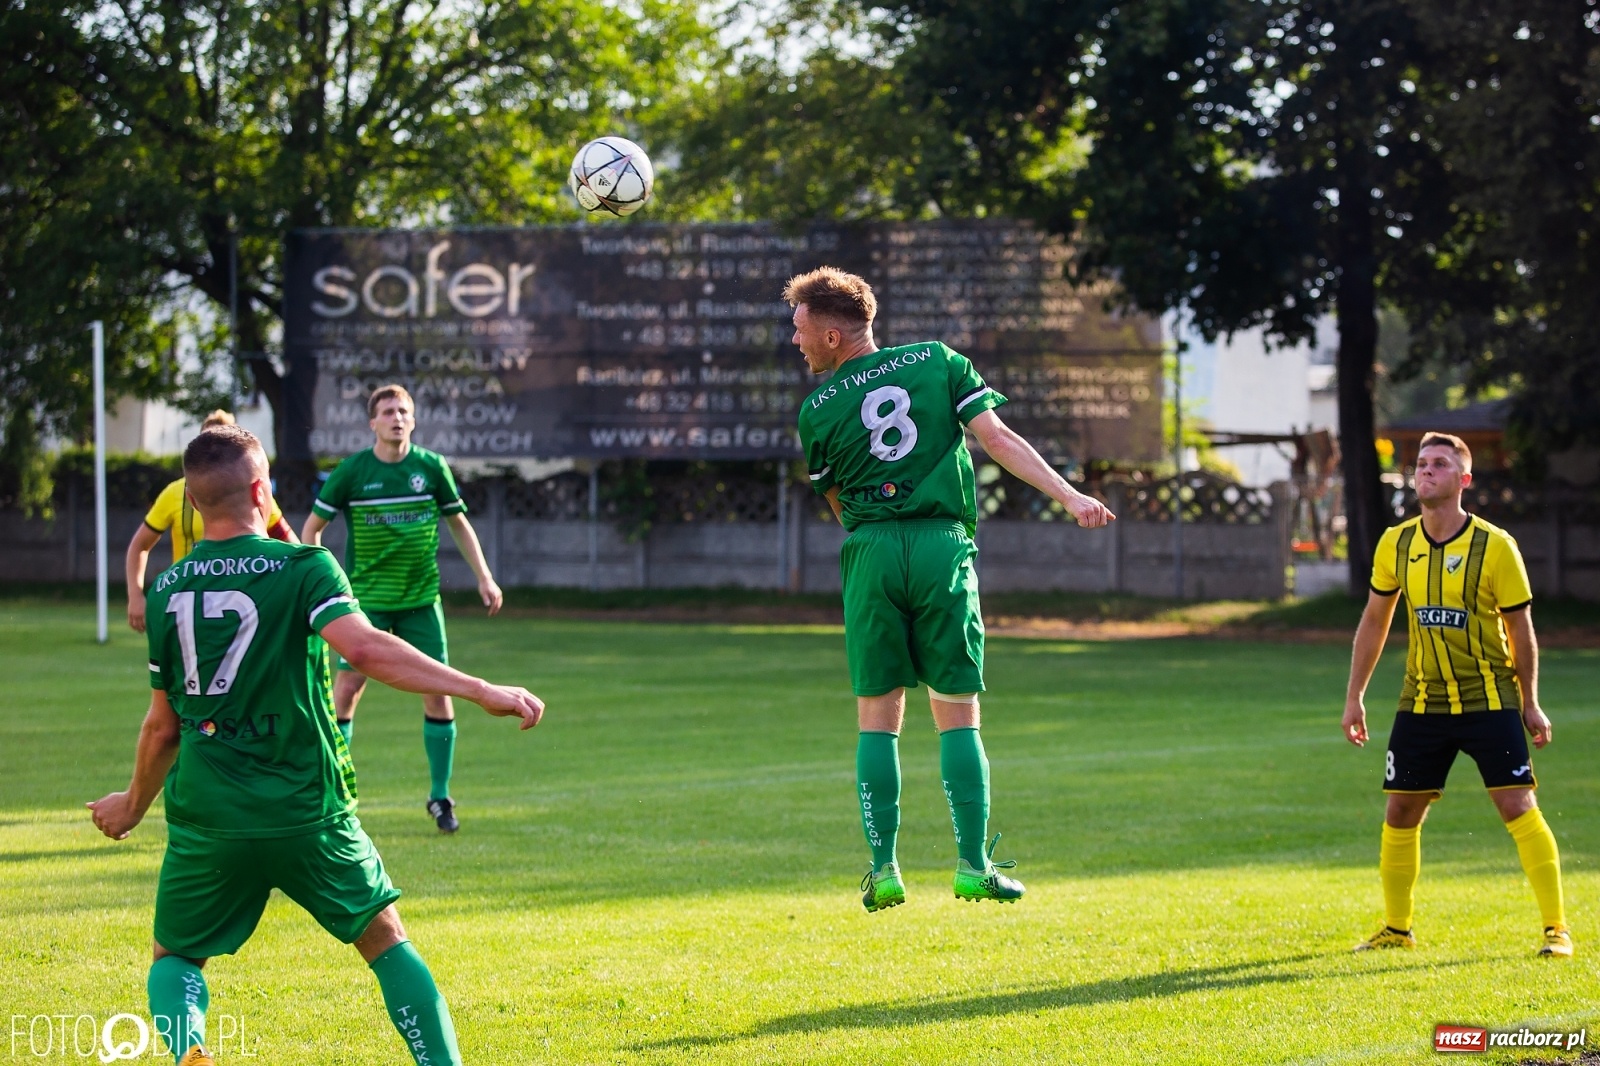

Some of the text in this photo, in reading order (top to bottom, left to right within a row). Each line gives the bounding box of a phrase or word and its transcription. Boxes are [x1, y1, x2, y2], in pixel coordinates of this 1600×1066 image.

[310, 239, 537, 318] safer
[811, 386, 837, 409] LKS
[840, 347, 932, 390] TWORKÓW
[309, 429, 534, 453] BUDLANYCH
[861, 385, 918, 462] 8
[155, 566, 179, 593] LKS
[165, 590, 259, 696] 17
[1416, 609, 1465, 626] EGET
[1385, 750, 1396, 782] 8
[397, 1005, 432, 1066] TWORK
